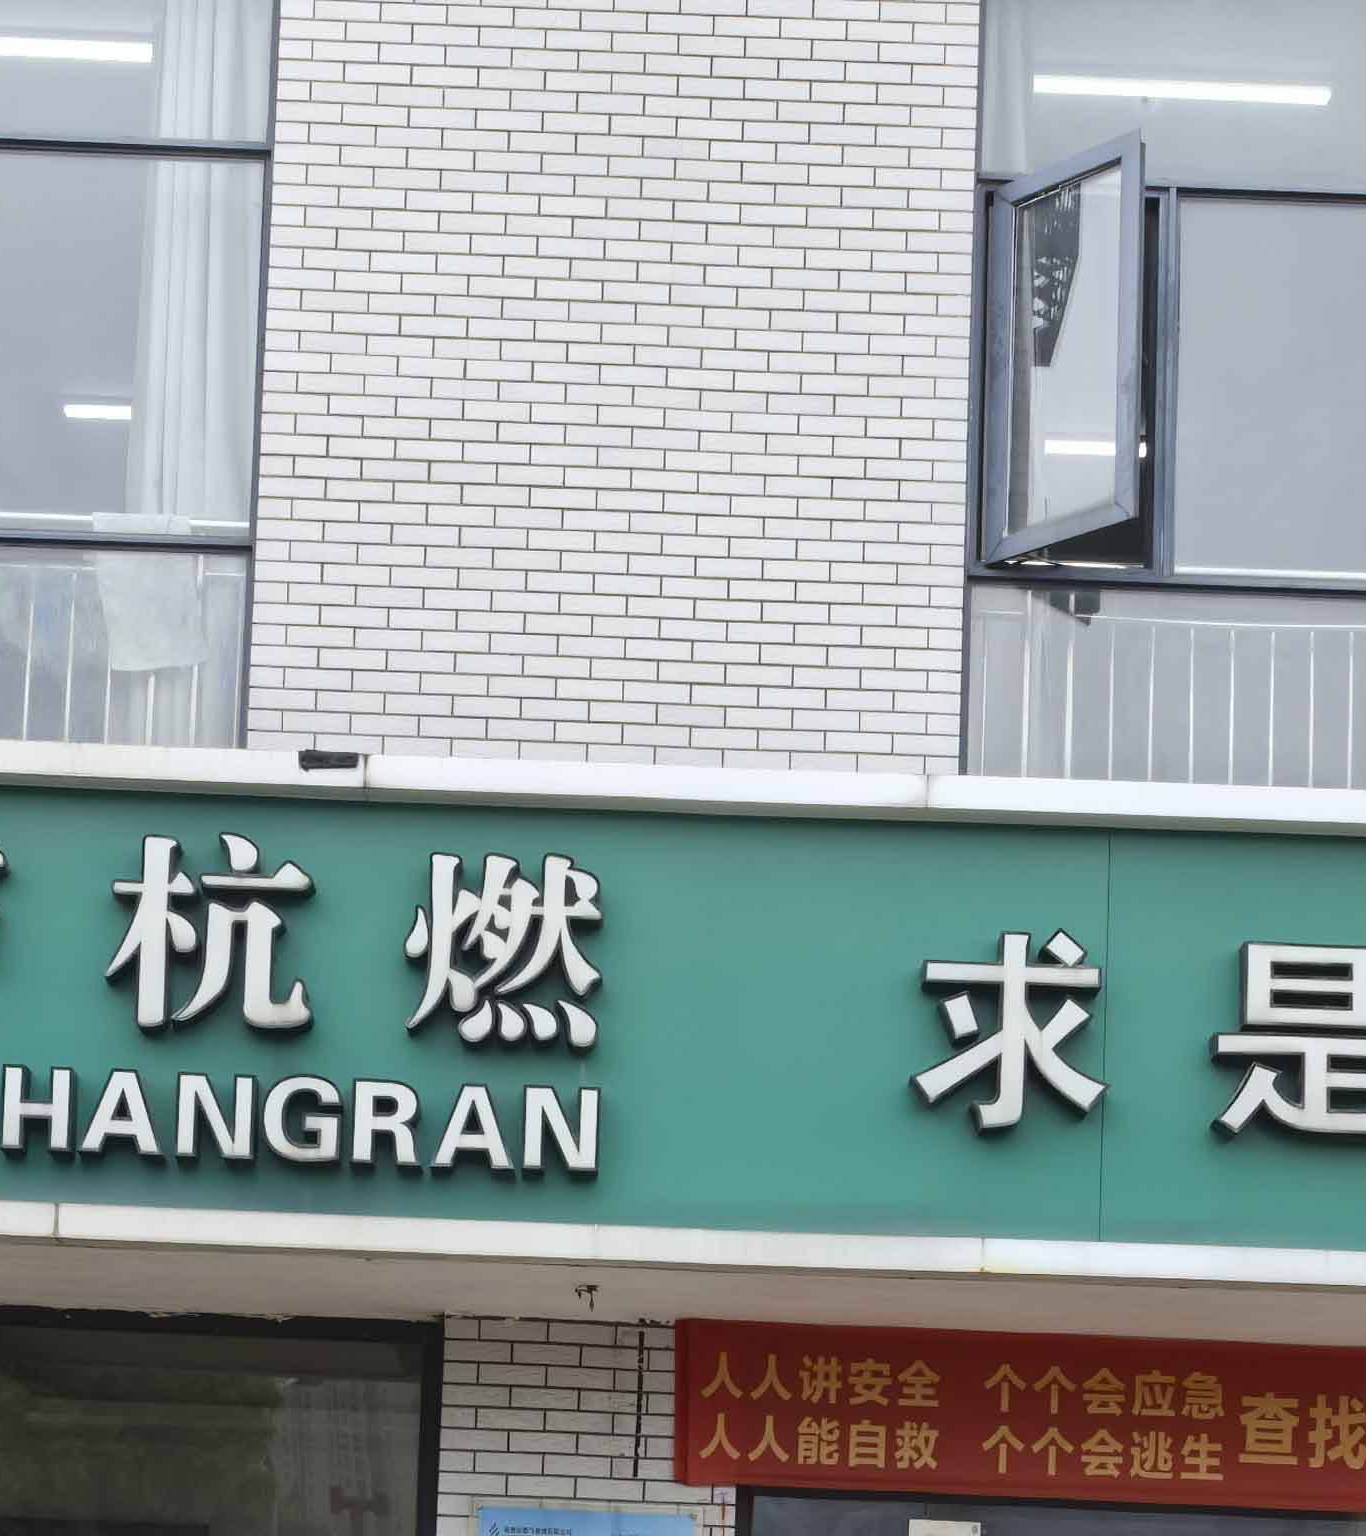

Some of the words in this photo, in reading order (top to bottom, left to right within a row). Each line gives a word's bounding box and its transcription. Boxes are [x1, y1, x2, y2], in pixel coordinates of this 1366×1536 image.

[700, 1352, 941, 1409] 人人讲安全
[982, 1362, 1225, 1420] 个个会应急
[699, 1412, 939, 1471] 人人能自救
[982, 1424, 1225, 1482] 个个会逃生
